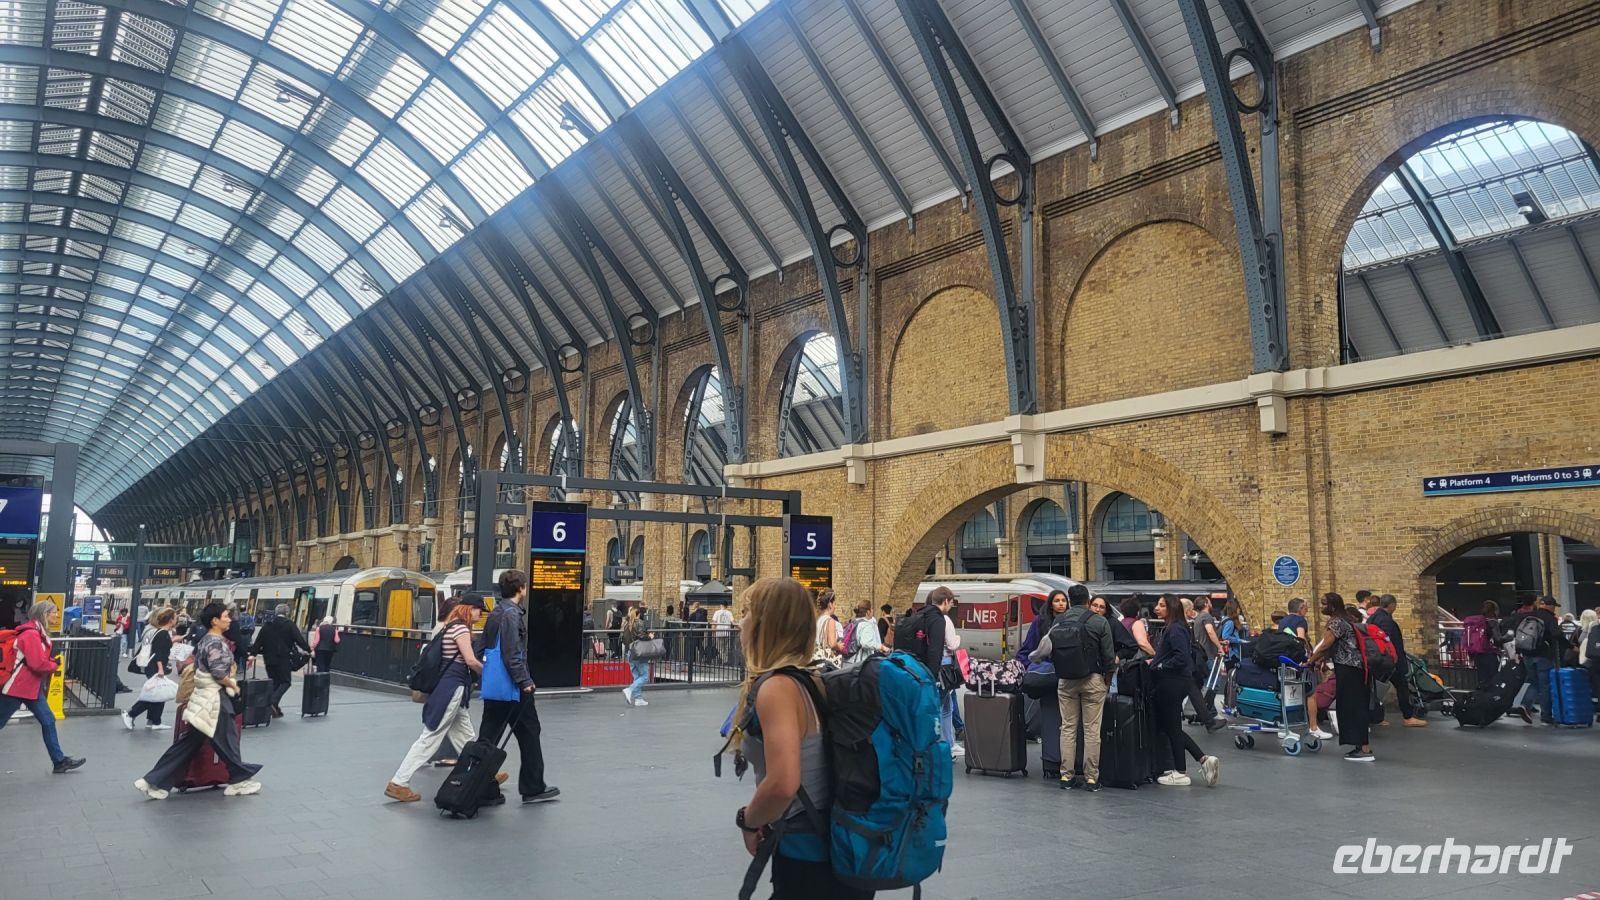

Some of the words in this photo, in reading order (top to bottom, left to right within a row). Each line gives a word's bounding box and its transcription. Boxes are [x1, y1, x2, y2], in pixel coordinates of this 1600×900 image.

[1449, 478, 1483, 488] Platform
[1485, 477, 1491, 485] 4
[1511, 473, 1552, 483] Platforms
[1554, 472, 1560, 480] 0
[1574, 471, 1580, 479] 3
[552, 522, 567, 542] 6
[806, 532, 817, 551] 5
[967, 608, 998, 624] LNER
